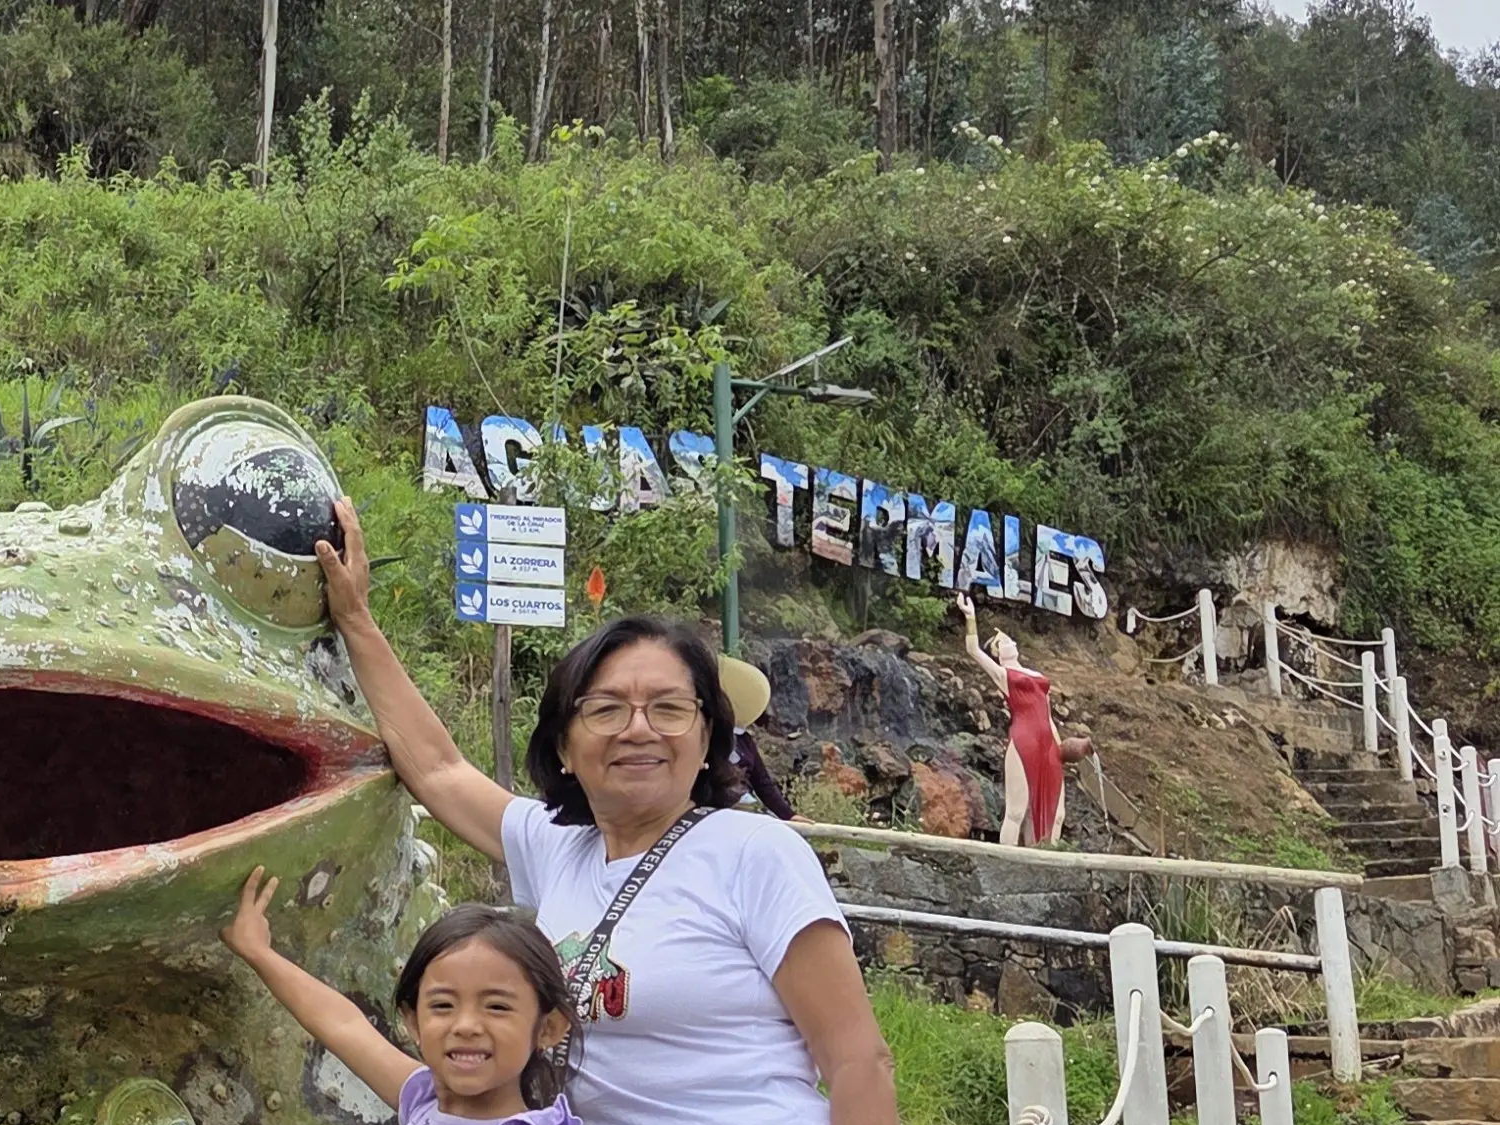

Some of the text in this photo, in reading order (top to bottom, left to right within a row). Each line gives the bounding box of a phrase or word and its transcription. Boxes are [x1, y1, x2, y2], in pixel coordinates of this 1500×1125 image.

[494, 555, 557, 568] LA ZORRERA
[760, 453, 1108, 619] TERMALES
[490, 598, 561, 610] LOS CUARTOS
[605, 819, 694, 921] FOREVER YOUNG
